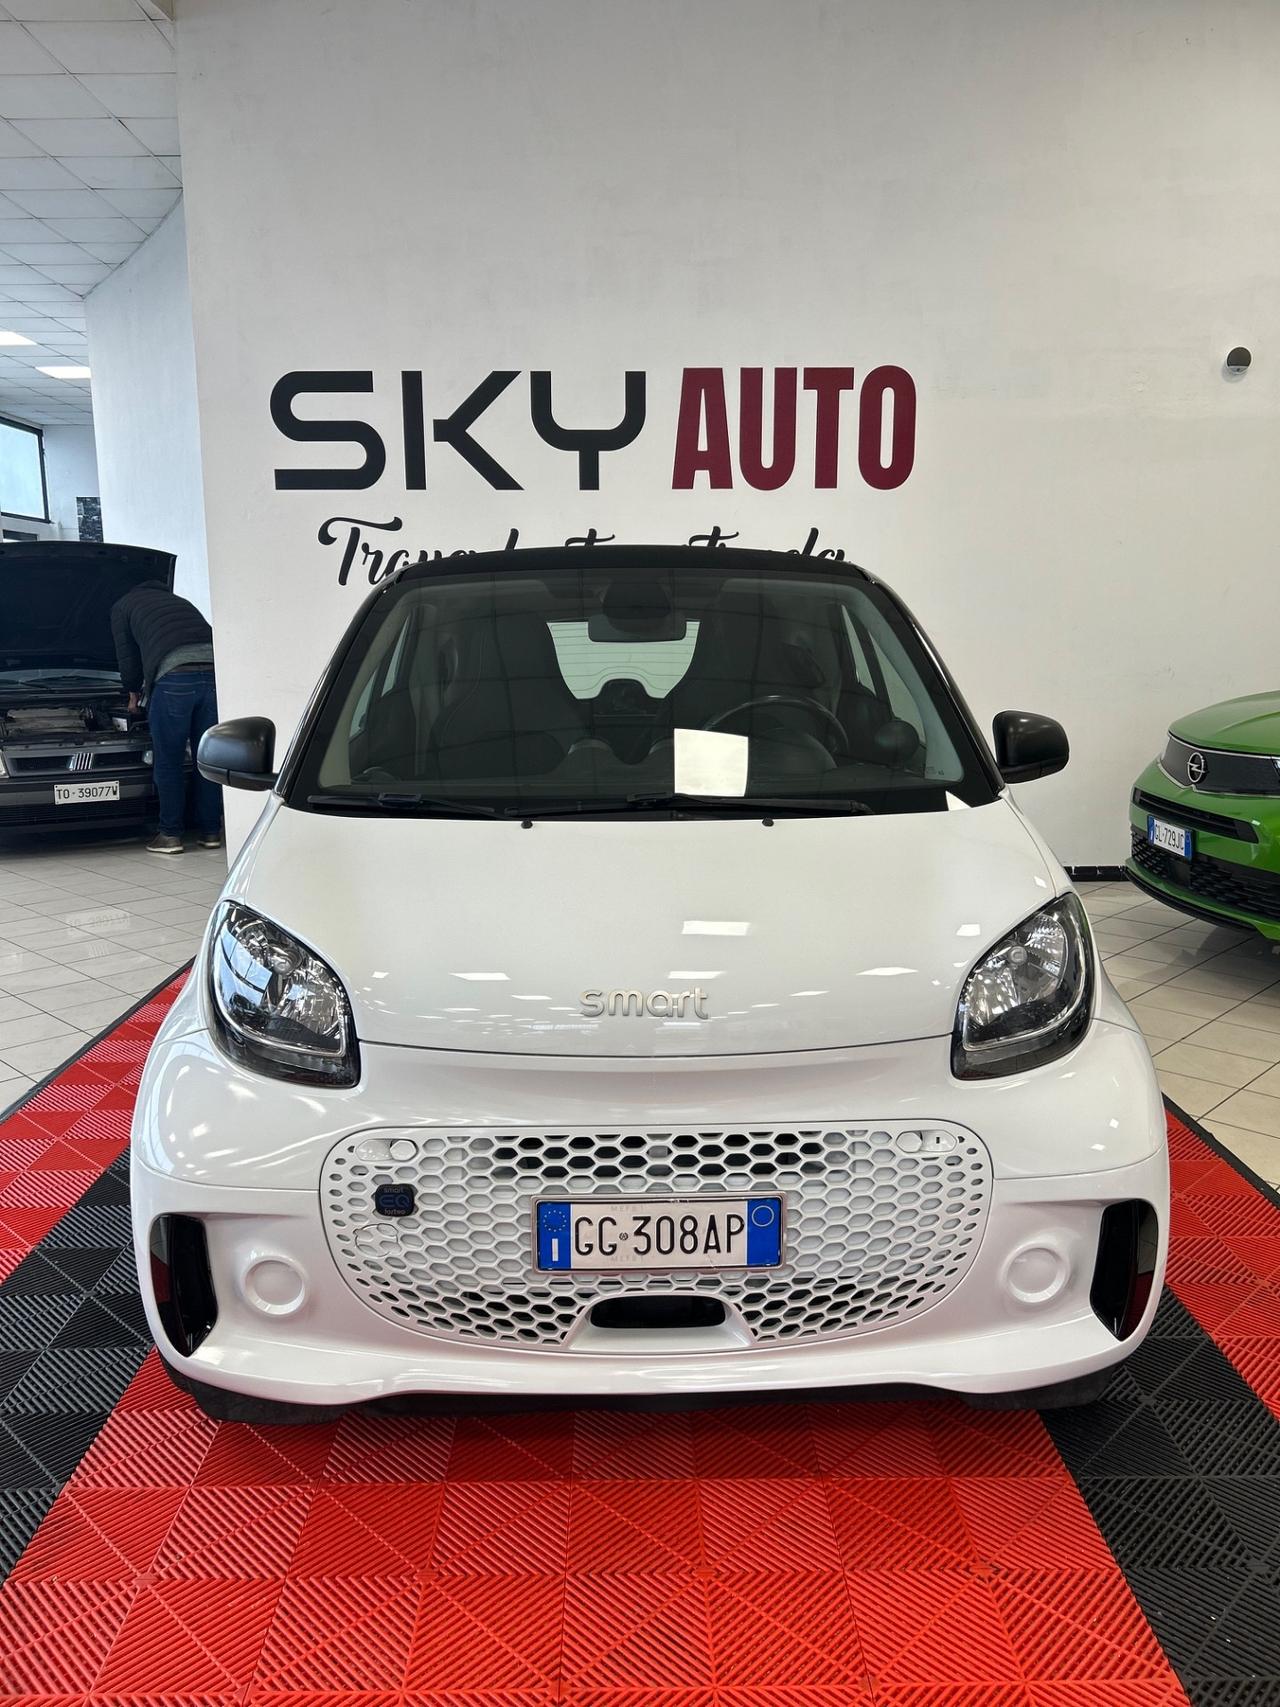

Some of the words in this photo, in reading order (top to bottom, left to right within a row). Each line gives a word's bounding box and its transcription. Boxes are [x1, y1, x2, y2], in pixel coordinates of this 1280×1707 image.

[269, 370, 647, 491] SKY
[671, 364, 918, 491] AUTO
[580, 986, 709, 1020] smart
